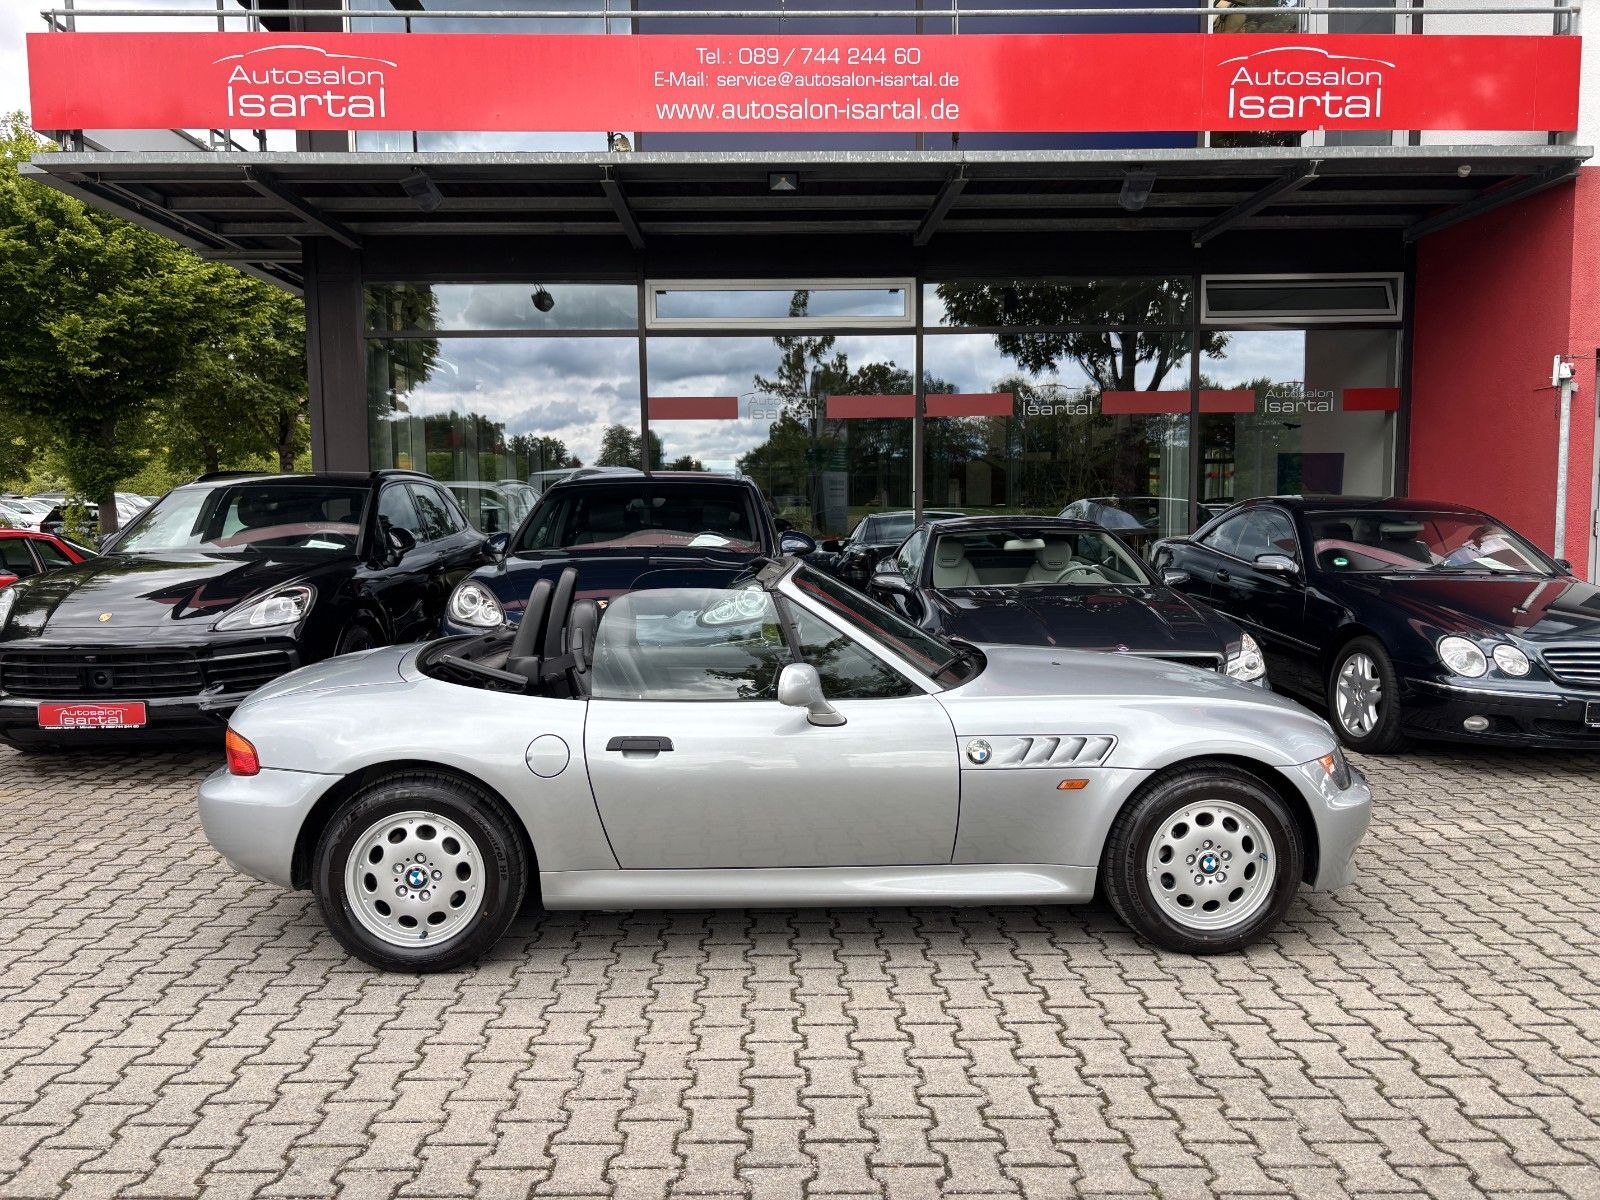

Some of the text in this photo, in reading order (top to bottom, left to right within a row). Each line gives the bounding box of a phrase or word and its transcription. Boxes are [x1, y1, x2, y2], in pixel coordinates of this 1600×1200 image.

[696, 48, 731, 64] Tel.:
[848, 48, 886, 64] 244
[895, 48, 920, 64] 60
[228, 65, 384, 85] Autosalon
[655, 72, 959, 88] E-Mail: service@autosalon-isartal.de
[1231, 66, 1382, 86] Autosalon
[228, 86, 385, 118] Isartal
[656, 98, 959, 120] www.autosalon-isartal.de
[1229, 87, 1381, 118] Isartal
[1265, 389, 1333, 398] Autosalon
[1022, 400, 1093, 415] Isartal
[1264, 398, 1334, 413] Isartal
[61, 708, 122, 716] Autosalon
